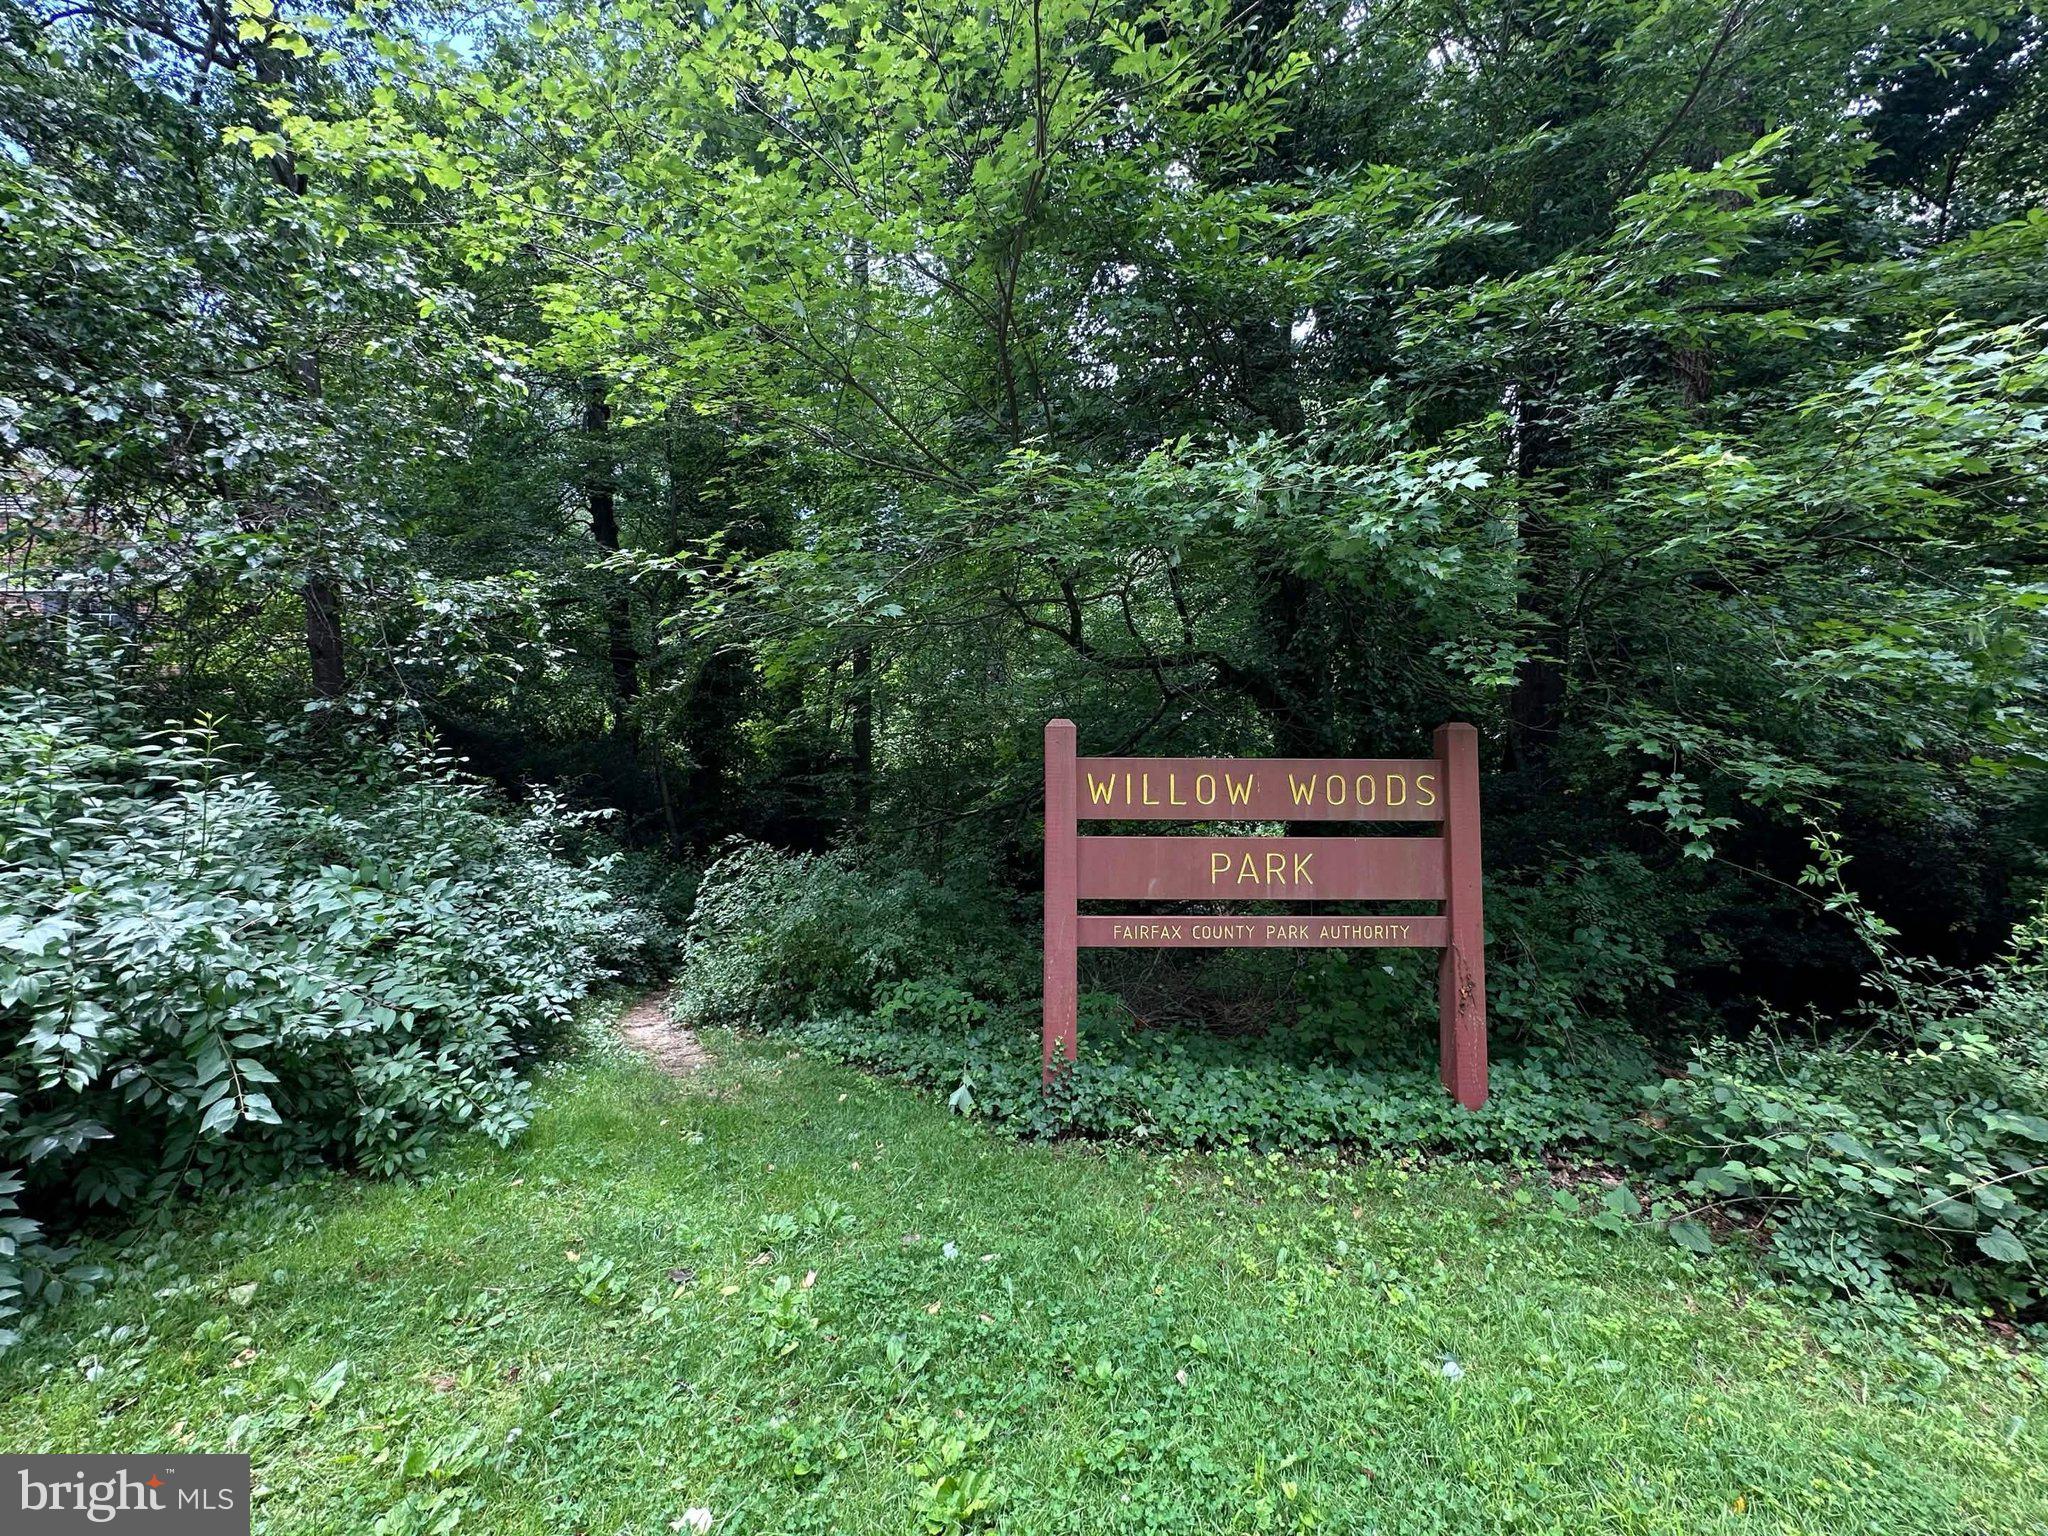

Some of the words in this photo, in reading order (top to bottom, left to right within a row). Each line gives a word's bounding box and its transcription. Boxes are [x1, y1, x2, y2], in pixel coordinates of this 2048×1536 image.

[1087, 773, 1254, 806] WILLOW
[1288, 773, 1437, 807] WOODS
[1211, 852, 1314, 885] PARK
[1113, 924, 1182, 940] FAIRFAX
[1192, 924, 1255, 940] COUNTY
[1266, 925, 1309, 940] PARK
[1320, 924, 1411, 940] AUTHORITY
